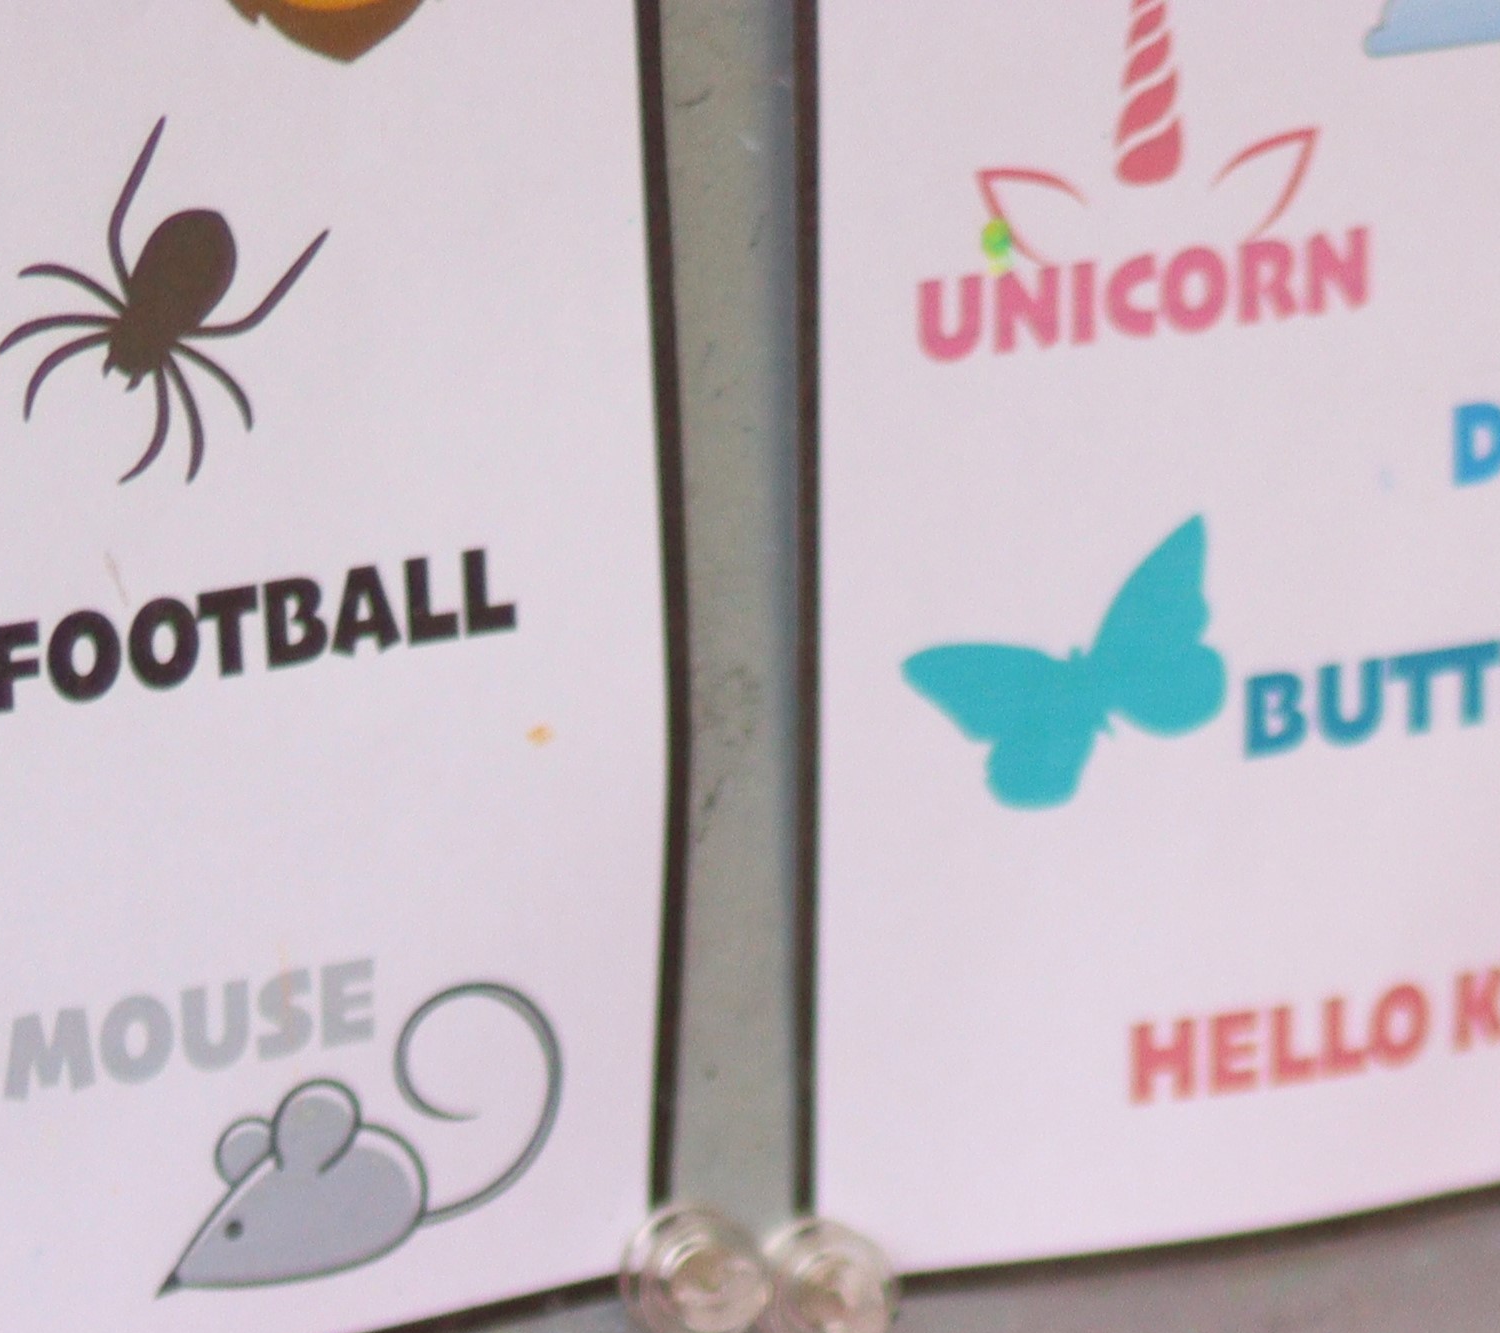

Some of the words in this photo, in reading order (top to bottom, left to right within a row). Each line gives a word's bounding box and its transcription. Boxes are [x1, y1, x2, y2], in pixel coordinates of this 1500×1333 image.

[917, 227, 1371, 363] UNICORN
[3, 957, 377, 1102] MOUSE
[1129, 981, 1434, 1105] HELLO
